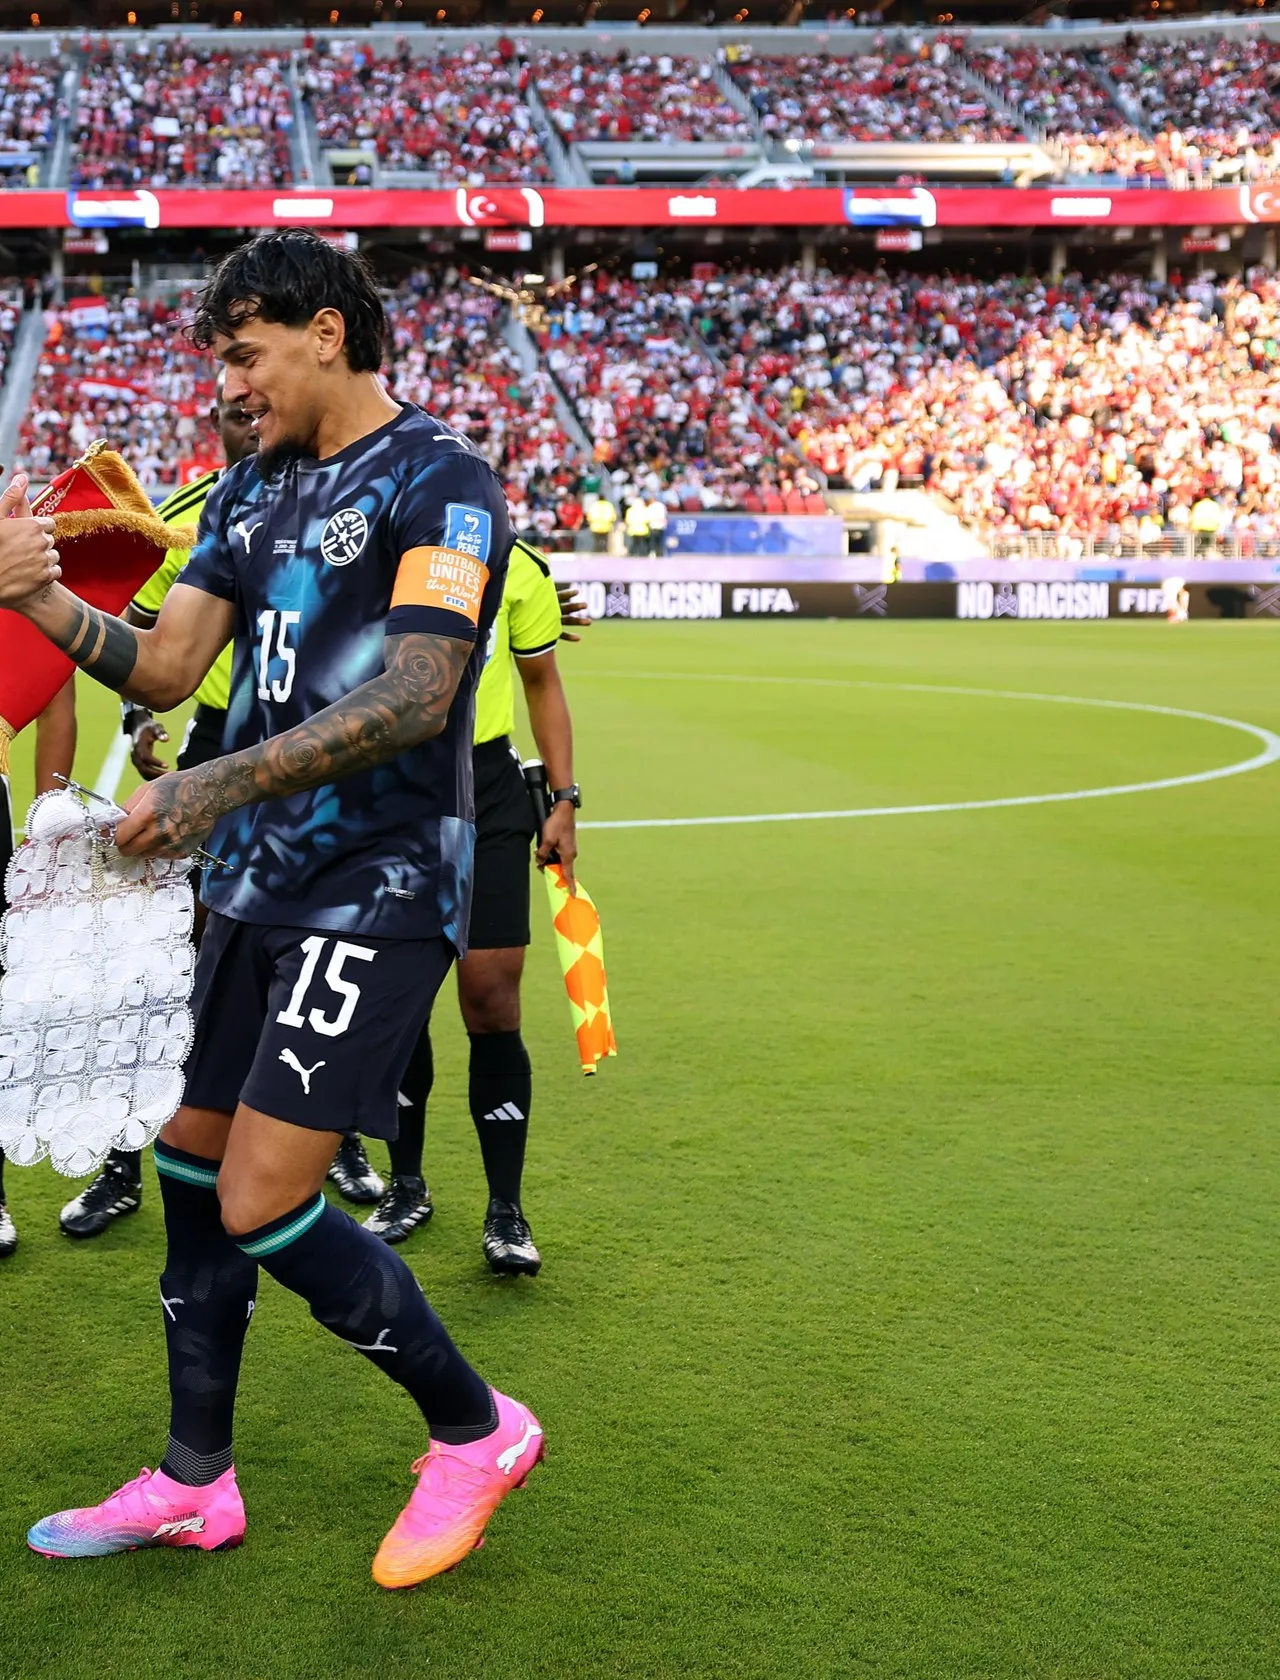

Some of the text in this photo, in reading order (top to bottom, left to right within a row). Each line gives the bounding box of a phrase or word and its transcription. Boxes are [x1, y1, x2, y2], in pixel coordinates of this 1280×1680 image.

[457, 541, 481, 557] PEACE
[429, 562, 480, 593] UNITES
[431, 550, 481, 579] FOOTBALL
[424, 578, 449, 591] the
[445, 595, 467, 609] FIFA
[629, 581, 723, 619] RACISM
[731, 587, 795, 613] FIFA
[957, 582, 1110, 619] NO RACISM
[256, 609, 302, 703] 15
[275, 934, 379, 1038] 15
